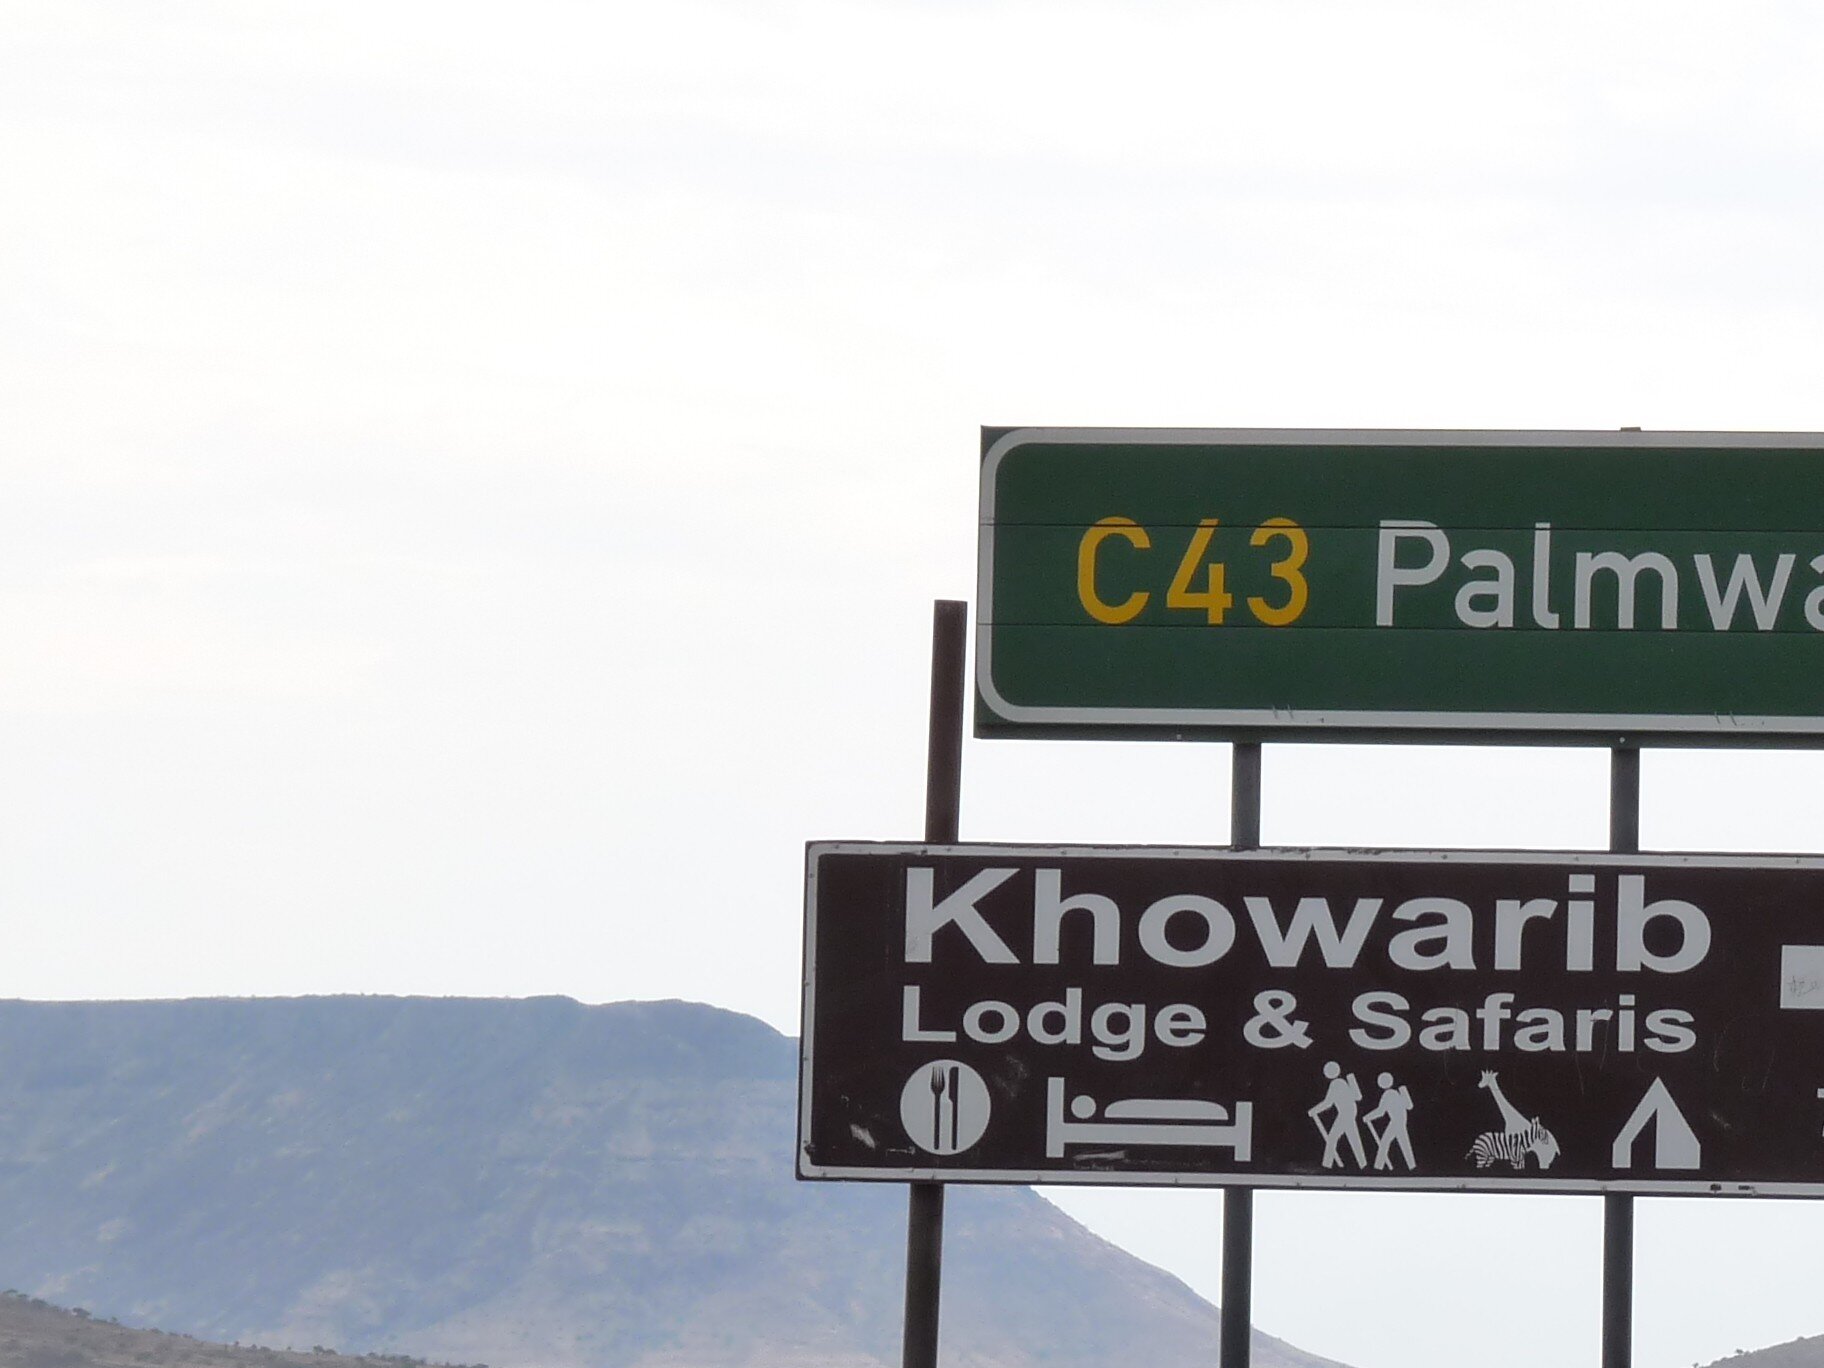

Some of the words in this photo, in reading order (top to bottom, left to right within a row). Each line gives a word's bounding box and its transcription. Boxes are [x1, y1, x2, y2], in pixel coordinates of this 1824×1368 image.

[1075, 516, 1309, 626] C43
[903, 866, 1713, 973] Khowarib
[901, 985, 1207, 1062] Lodge
[1243, 990, 1310, 1051] &
[1350, 990, 1697, 1054] Safaris
